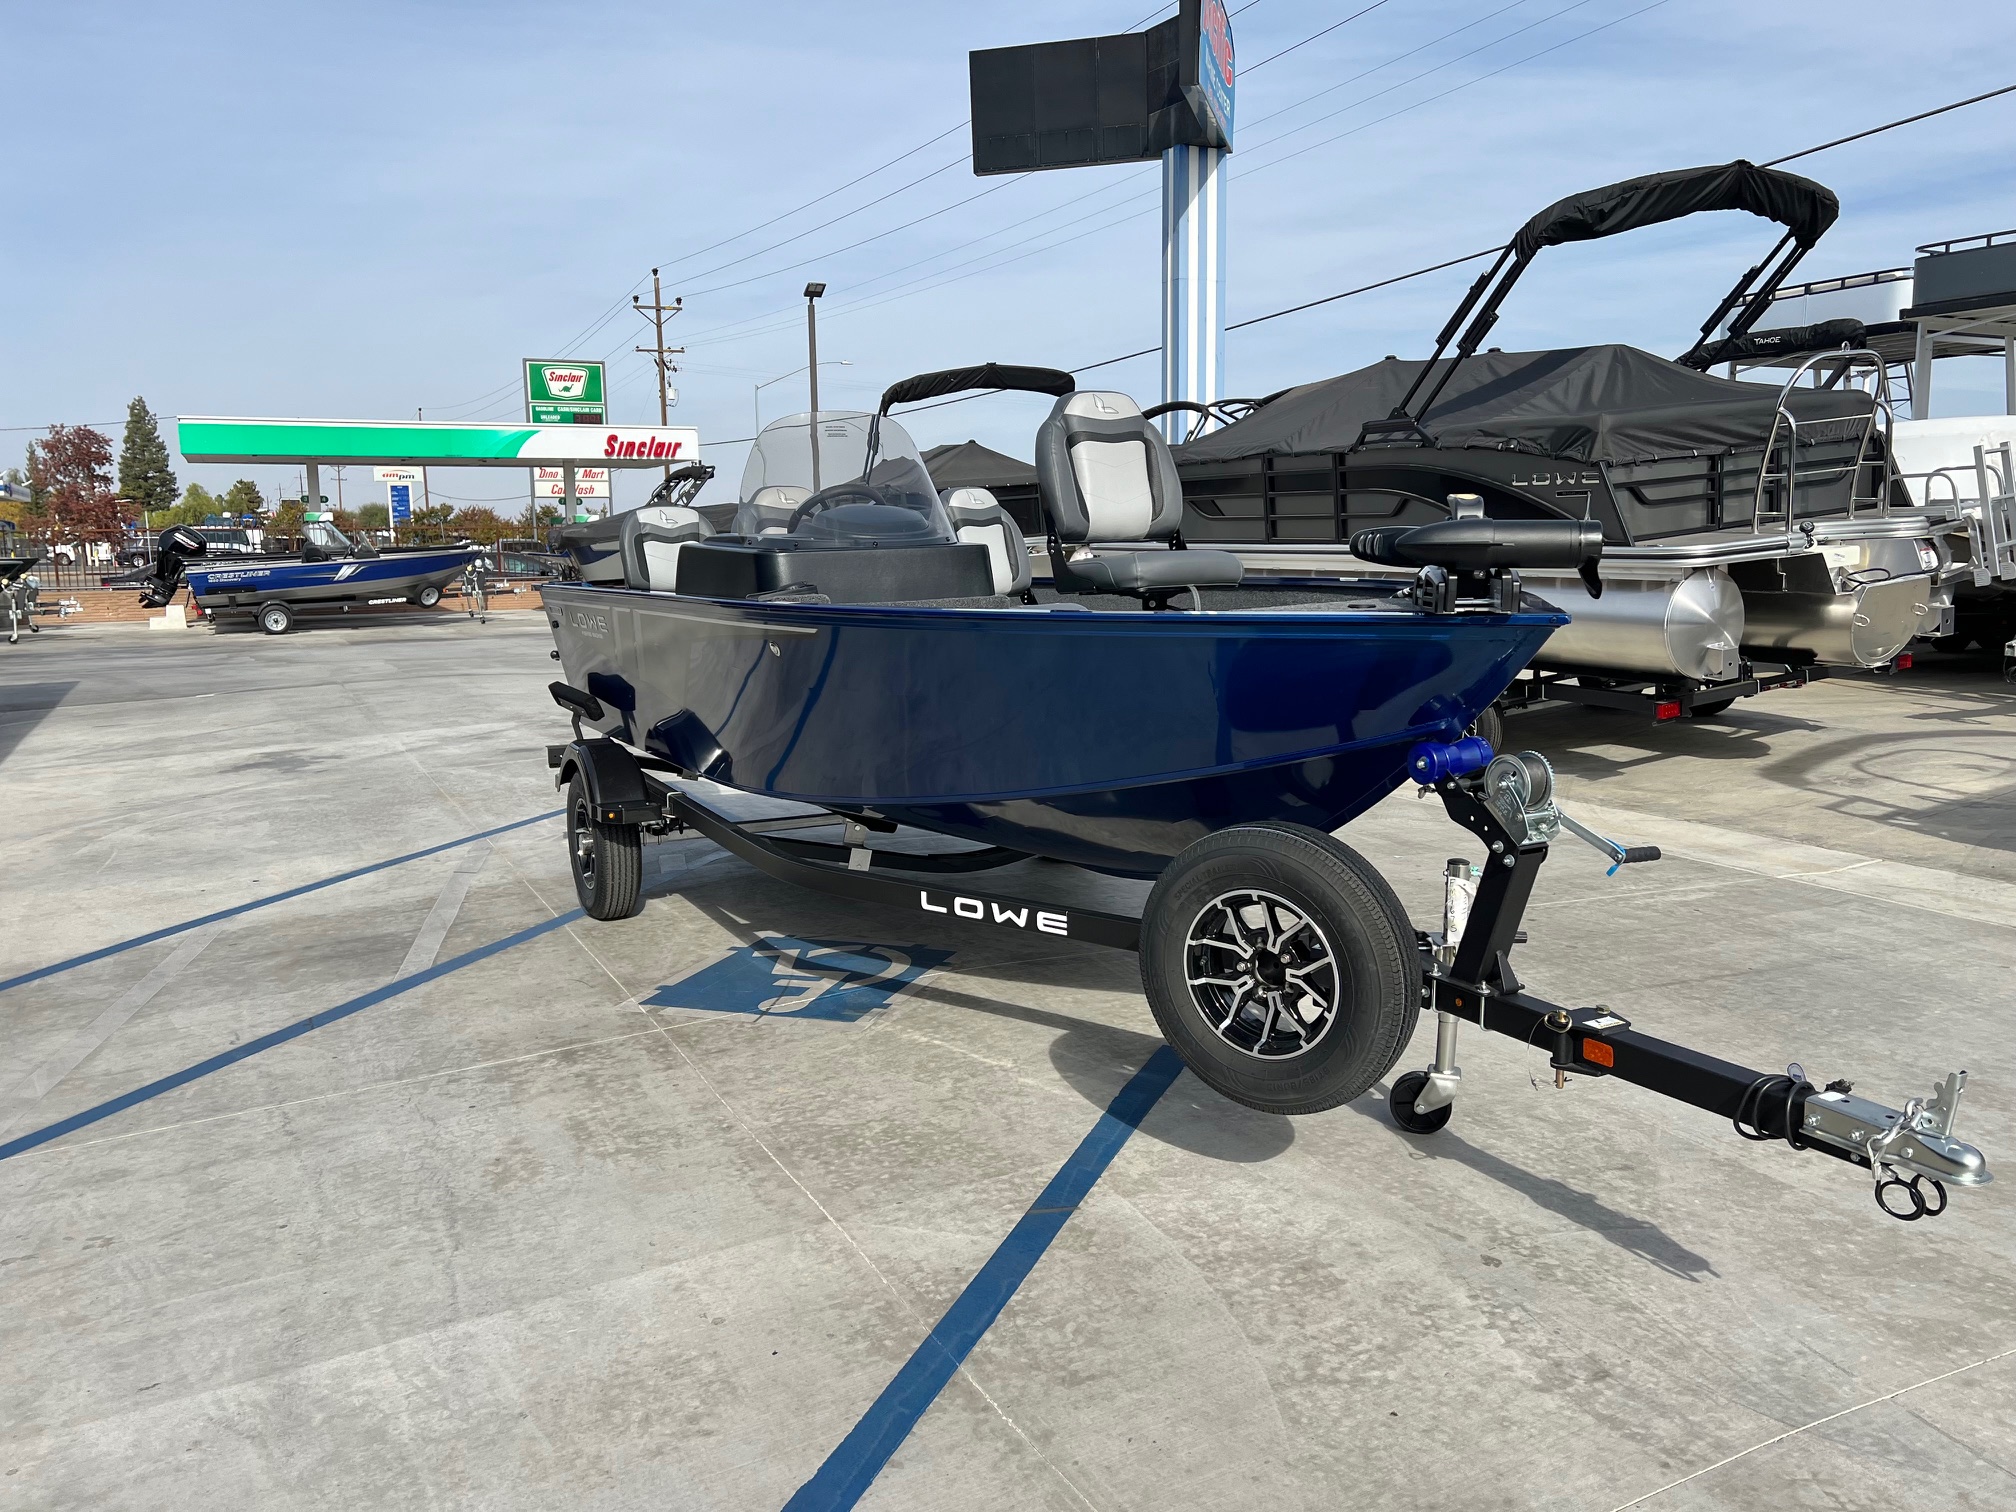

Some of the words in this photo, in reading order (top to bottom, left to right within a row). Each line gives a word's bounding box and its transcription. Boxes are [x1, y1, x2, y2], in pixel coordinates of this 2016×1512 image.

[1754, 336, 1781, 346] TAHOE
[548, 371, 583, 383] Sinclair
[604, 434, 682, 459] Sinclair
[539, 468, 558, 479] Dino
[582, 469, 604, 479] Mart
[1512, 472, 1600, 486] LOWE
[207, 570, 271, 580] CRESTLINER
[368, 597, 407, 605] CRESTLINER
[569, 611, 609, 633] LOWE
[920, 891, 1068, 936] LOWE
